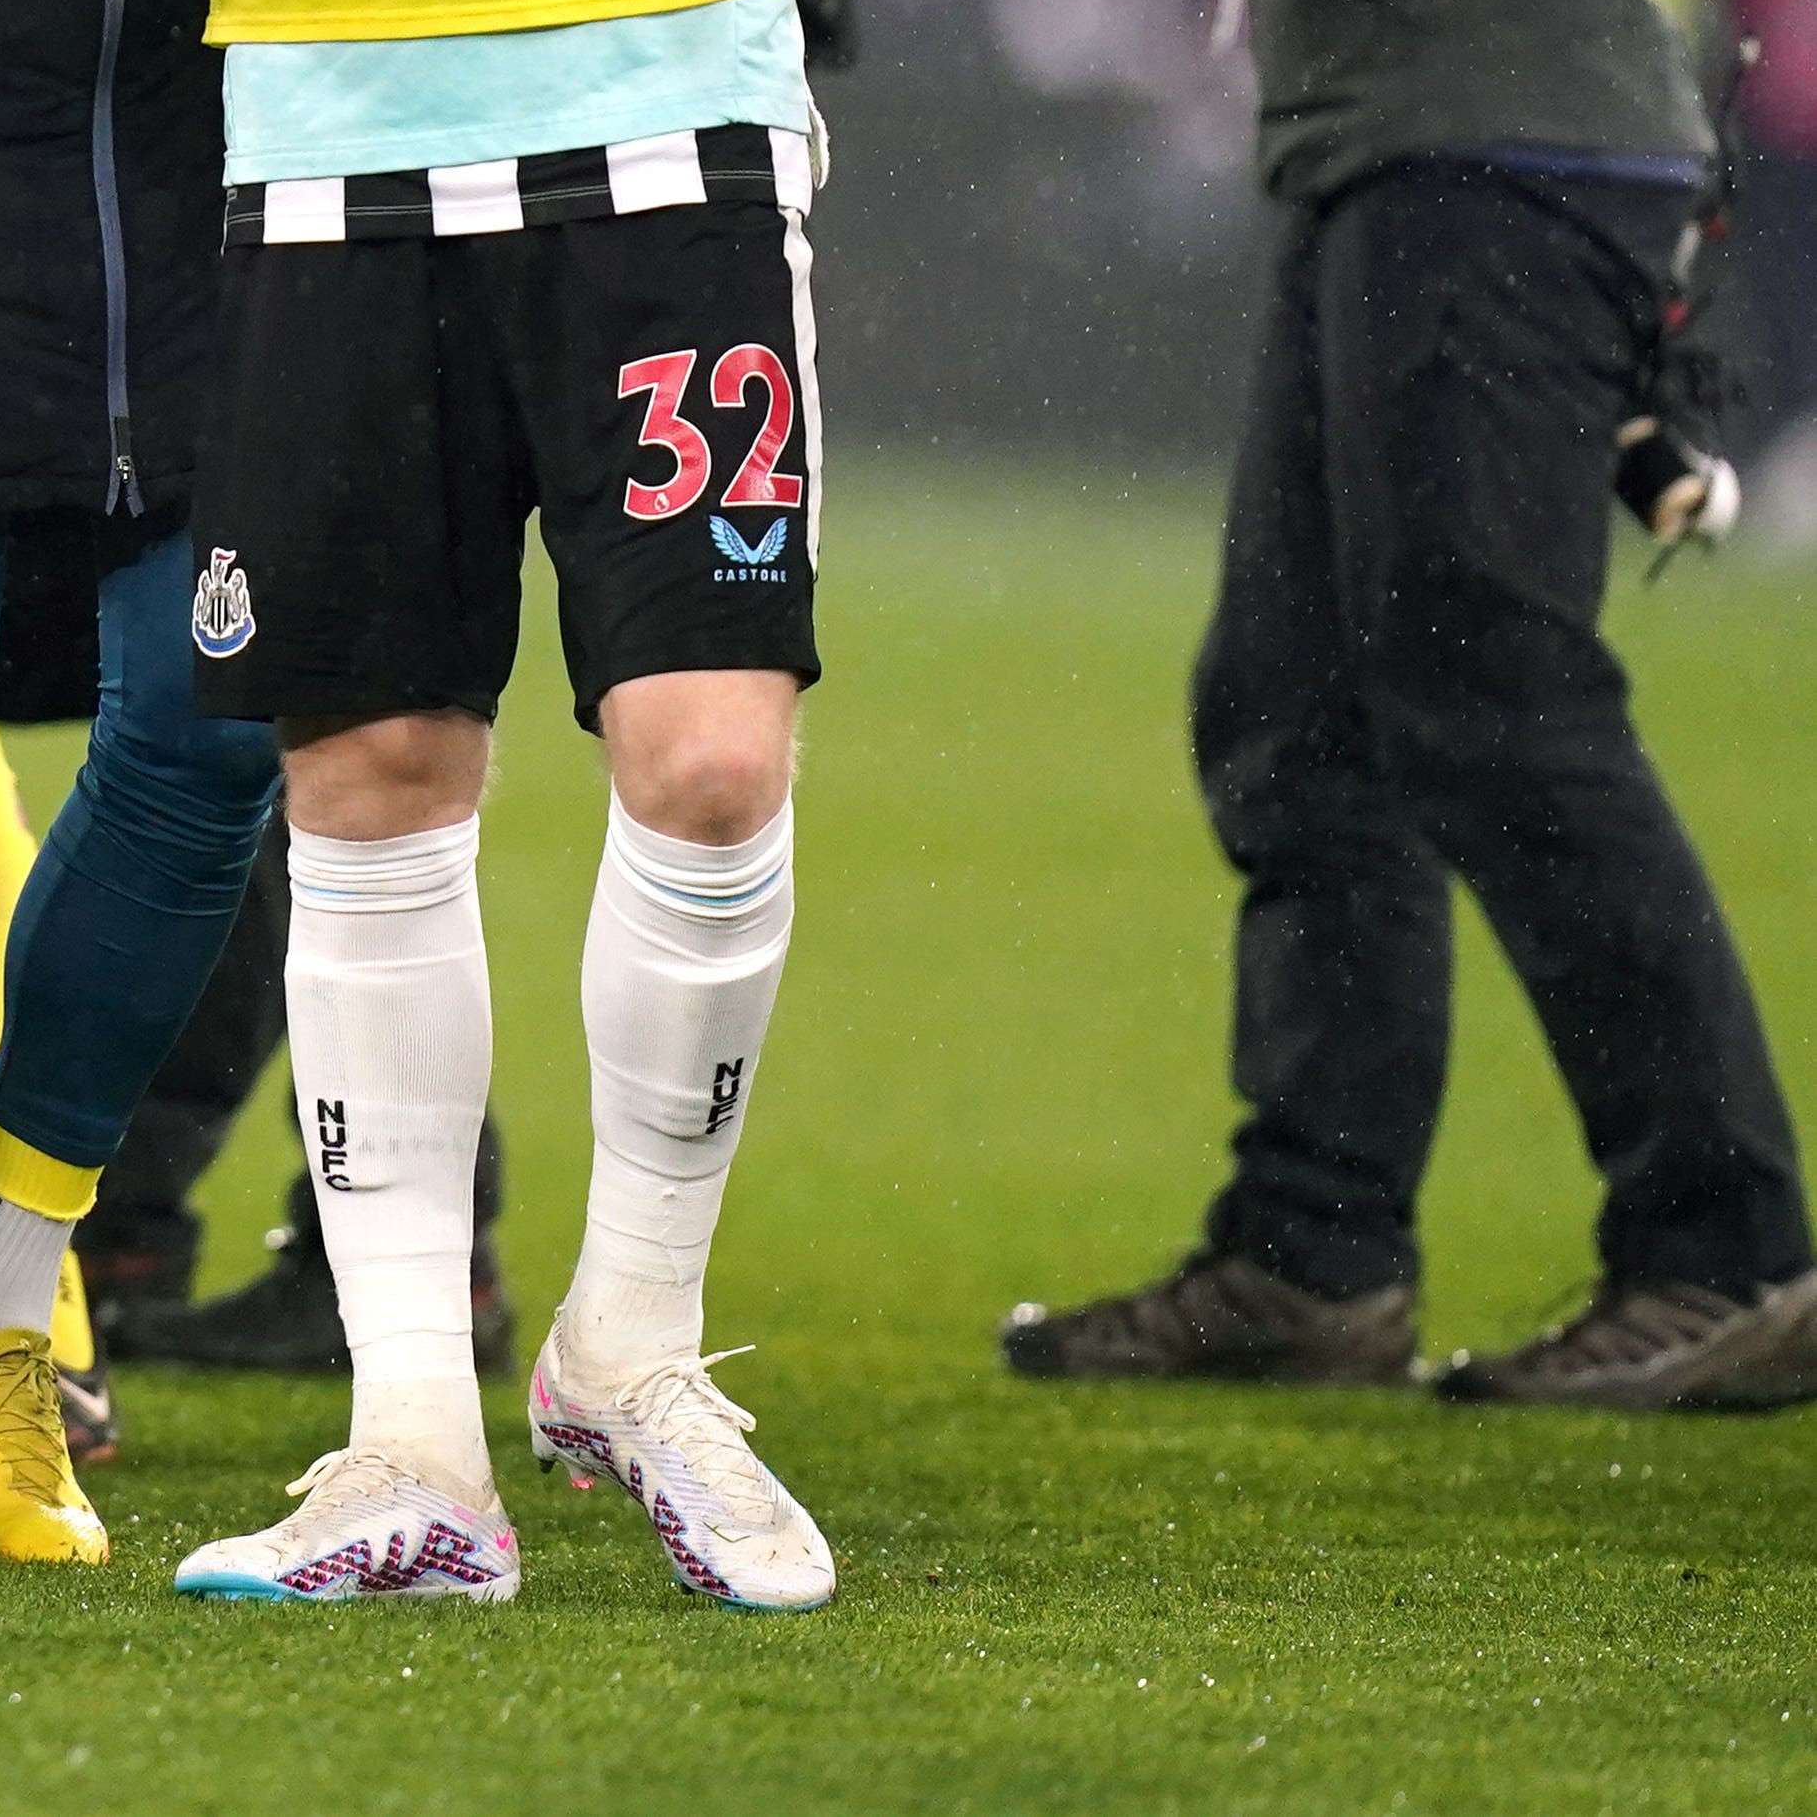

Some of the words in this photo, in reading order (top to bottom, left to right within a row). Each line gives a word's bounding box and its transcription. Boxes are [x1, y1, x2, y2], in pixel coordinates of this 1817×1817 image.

[617, 342, 804, 521] 32
[714, 568, 787, 582] CASTORE
[317, 1098, 353, 1192] NUFC
